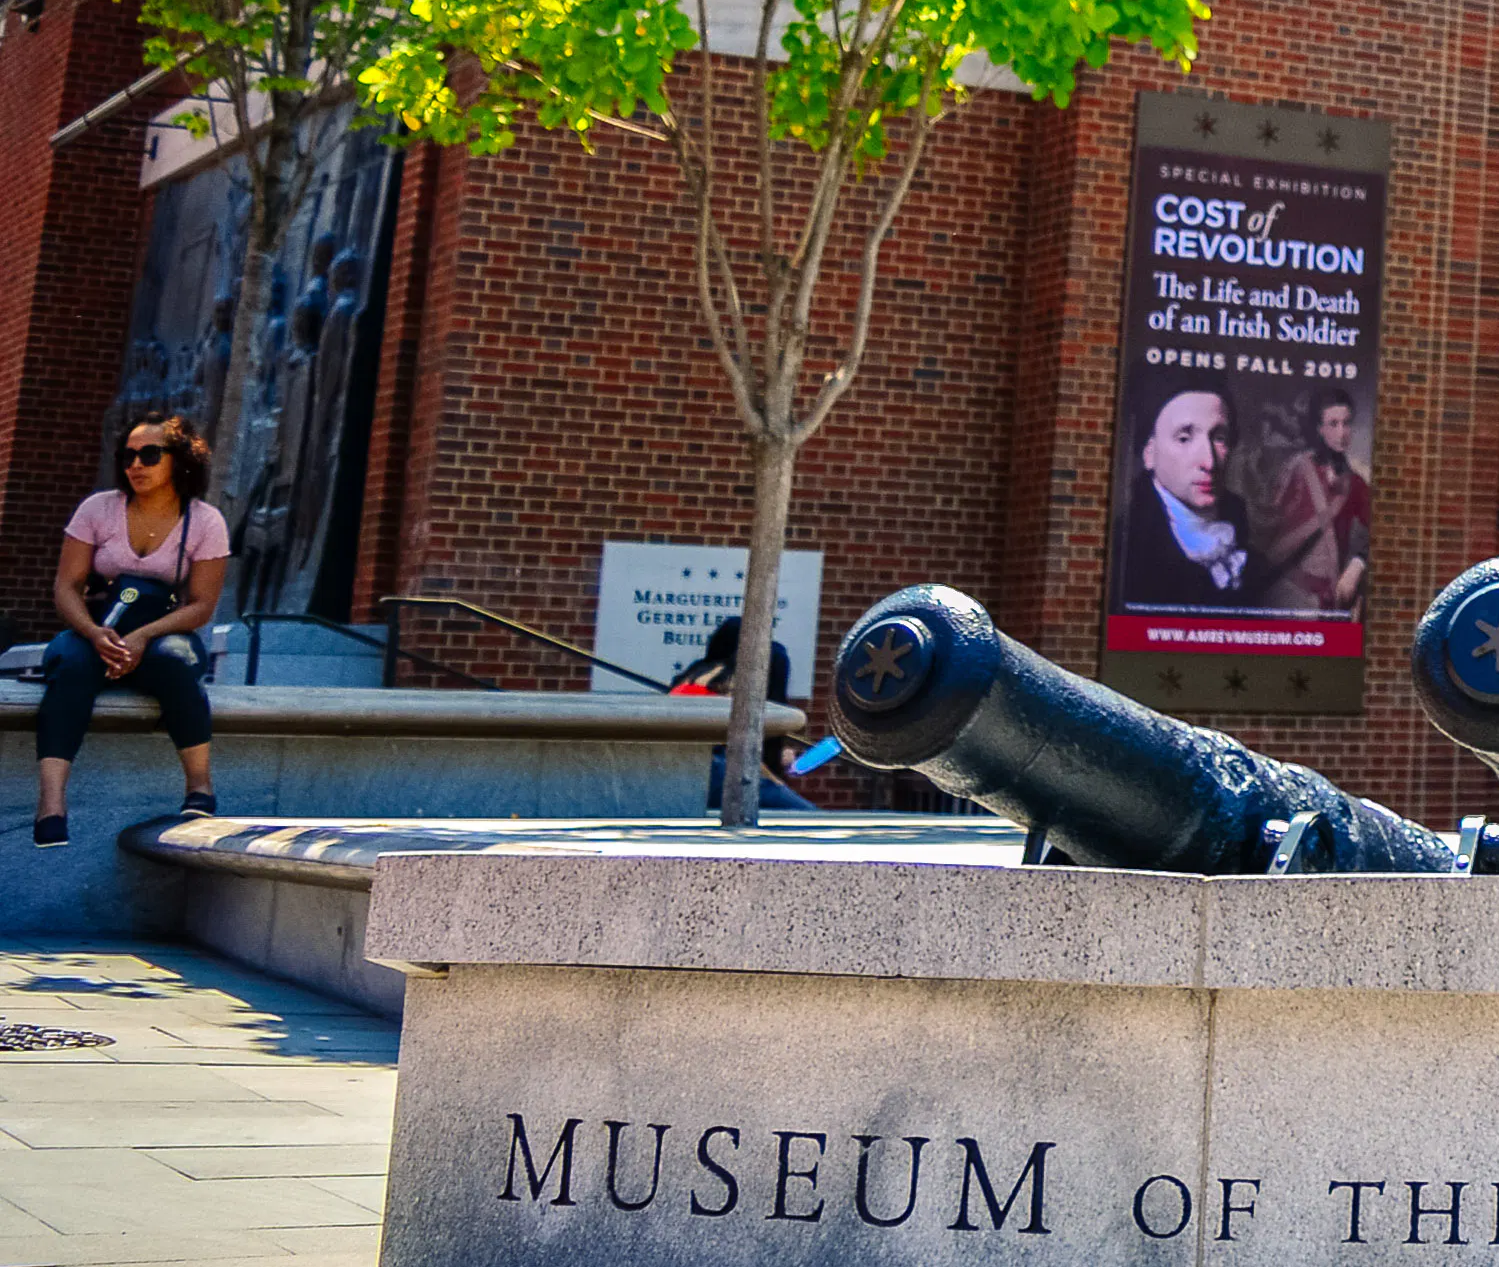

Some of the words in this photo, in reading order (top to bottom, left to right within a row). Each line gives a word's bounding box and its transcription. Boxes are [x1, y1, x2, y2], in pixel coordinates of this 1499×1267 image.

[1158, 164, 1243, 187] SPECIAL
[1253, 176, 1368, 201] EXHIBITION
[1155, 193, 1246, 230] COST
[1247, 200, 1286, 242] of
[1153, 226, 1365, 275] REVOLUTION
[1153, 271, 1198, 300] The
[1202, 275, 1246, 305] Life
[1249, 284, 1290, 310] and
[1296, 285, 1361, 315] Death
[1148, 302, 1181, 331] of
[1180, 314, 1211, 334] an
[1218, 309, 1271, 340] Irish
[1277, 313, 1360, 347] Soldier
[1146, 346, 1226, 370] OPENS
[1236, 355, 1294, 376] FALL
[1303, 360, 1358, 380] 2019
[633, 590, 745, 608] MARGUERIT
[637, 610, 697, 626] GERRY
[497, 1112, 1058, 1235] MUSEUM
[1132, 1172, 1263, 1242] OF
